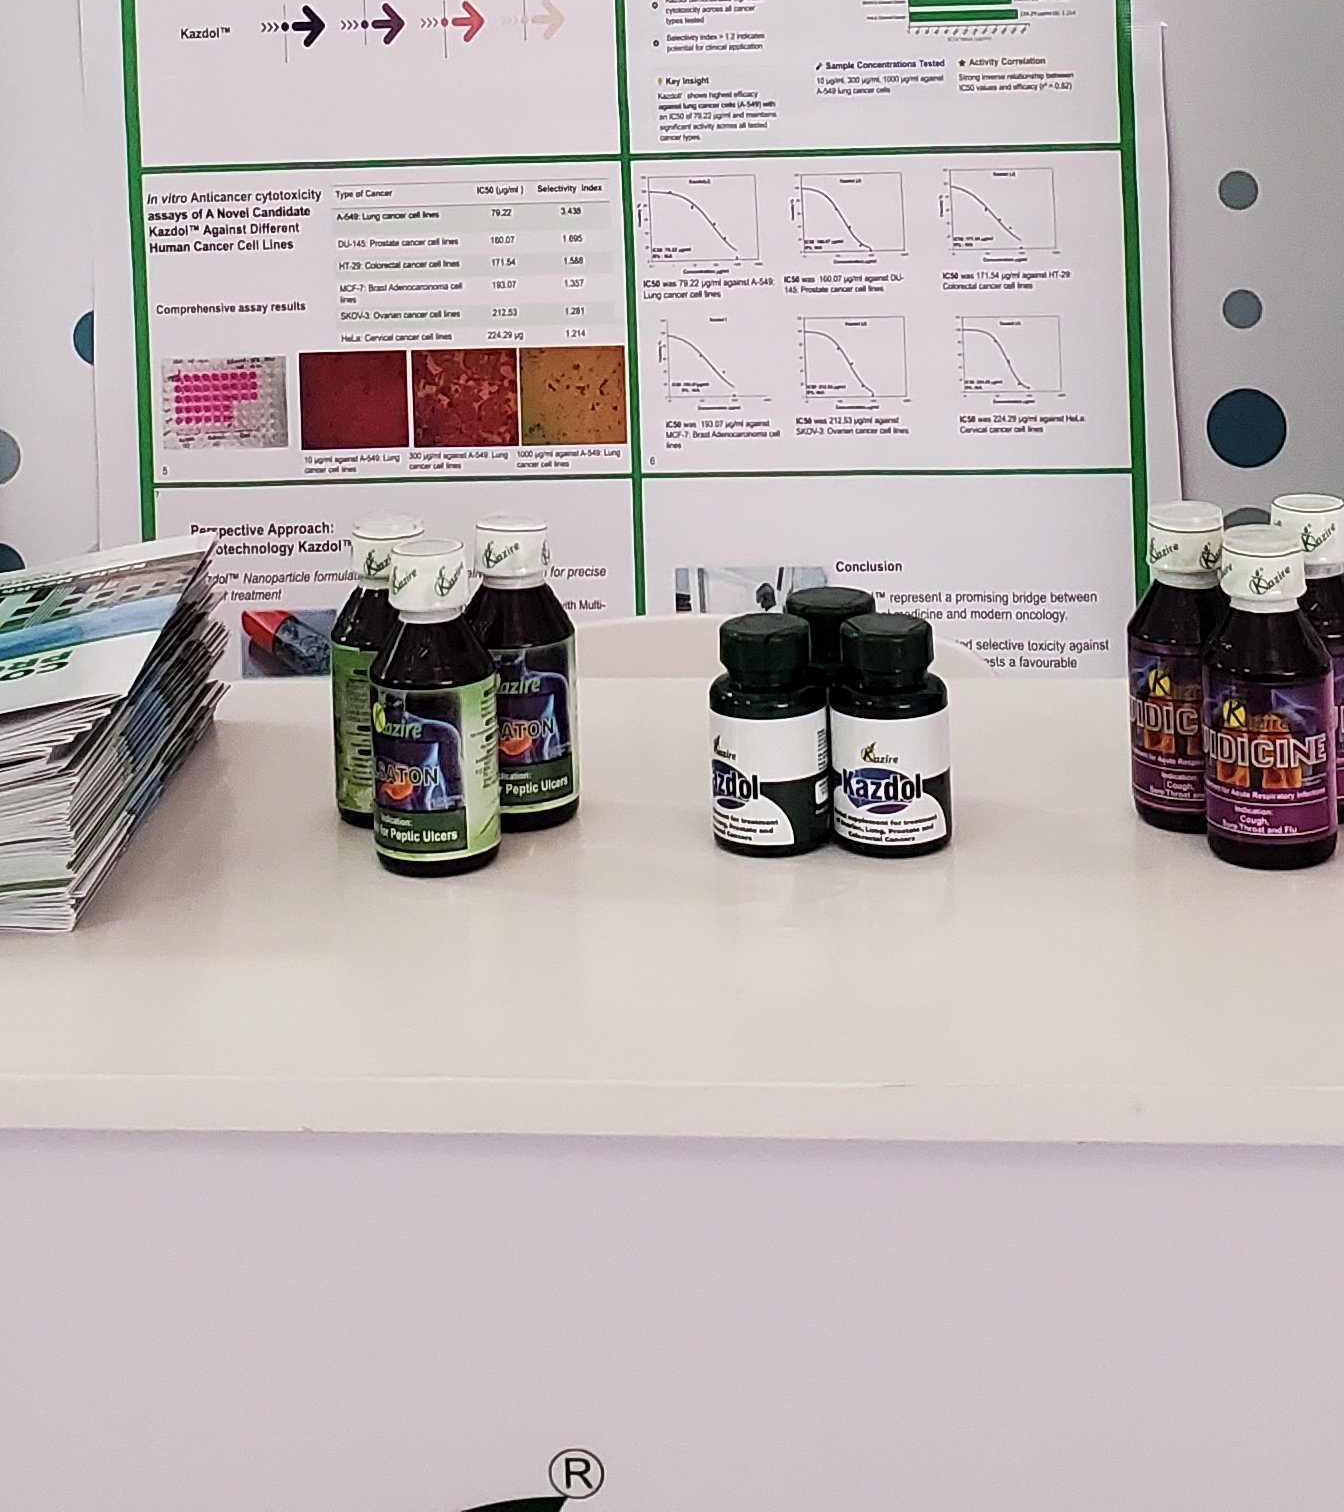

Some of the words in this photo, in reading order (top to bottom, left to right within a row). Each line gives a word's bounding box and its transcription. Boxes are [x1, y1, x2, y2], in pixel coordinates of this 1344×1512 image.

[146, 193, 158, 205] In
[161, 192, 188, 205] vitro
[190, 191, 253, 204] Anticancer
[256, 189, 321, 204] cytotoxicity
[156, 303, 236, 317] Comprehensive
[238, 304, 269, 315] assay
[270, 301, 306, 312] results
[268, 522, 333, 538] Approach:
[835, 560, 903, 573] Conclusion
[889, 591, 943, 606] represent
[944, 593, 952, 603] a
[955, 593, 1009, 606] promising
[1012, 591, 1047, 606] bridge
[1050, 591, 1098, 603] between
[842, 768, 921, 802] Kazdol
[390, 827, 421, 843] Peptic
[422, 829, 458, 843] Ulcers
